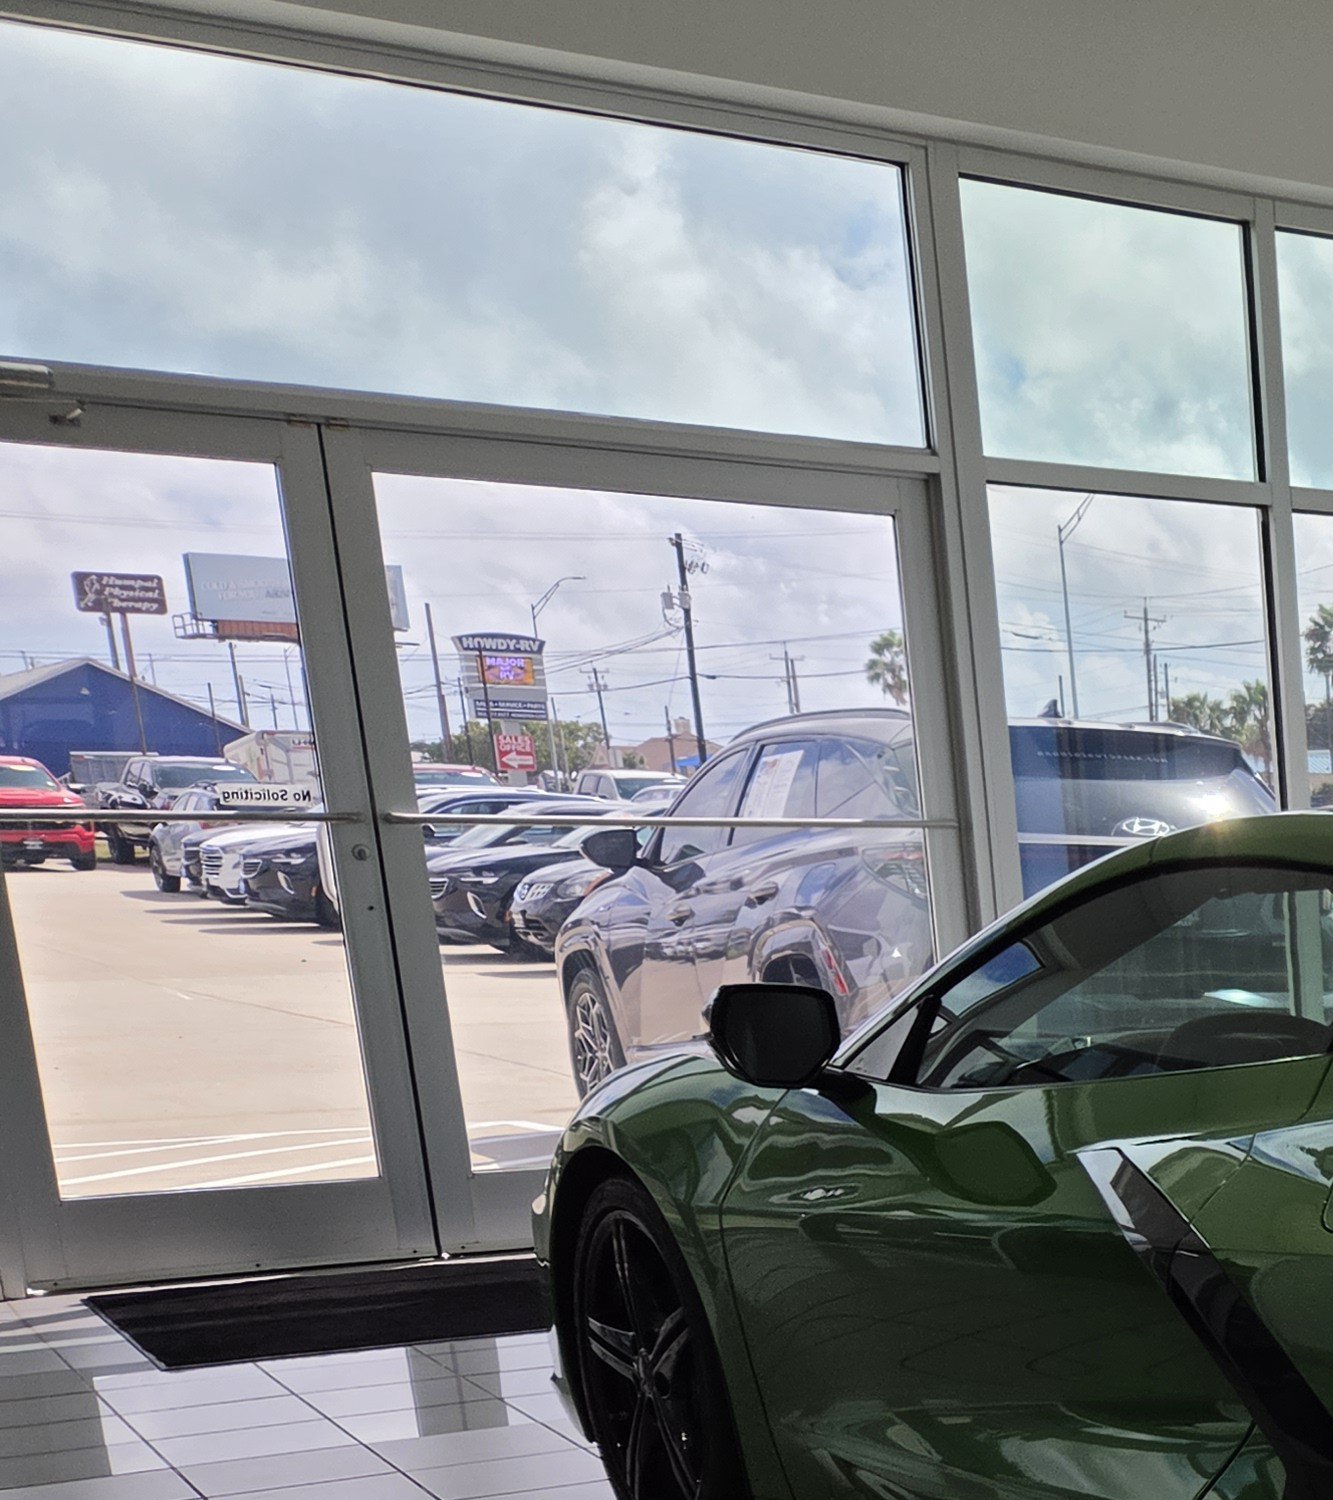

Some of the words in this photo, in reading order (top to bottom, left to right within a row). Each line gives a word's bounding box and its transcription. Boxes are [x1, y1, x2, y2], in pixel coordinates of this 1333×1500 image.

[104, 587, 159, 599] Physical
[108, 598, 159, 611] Therapy
[461, 637, 540, 652] HOWDY-RV
[486, 657, 525, 668] MAJOR
